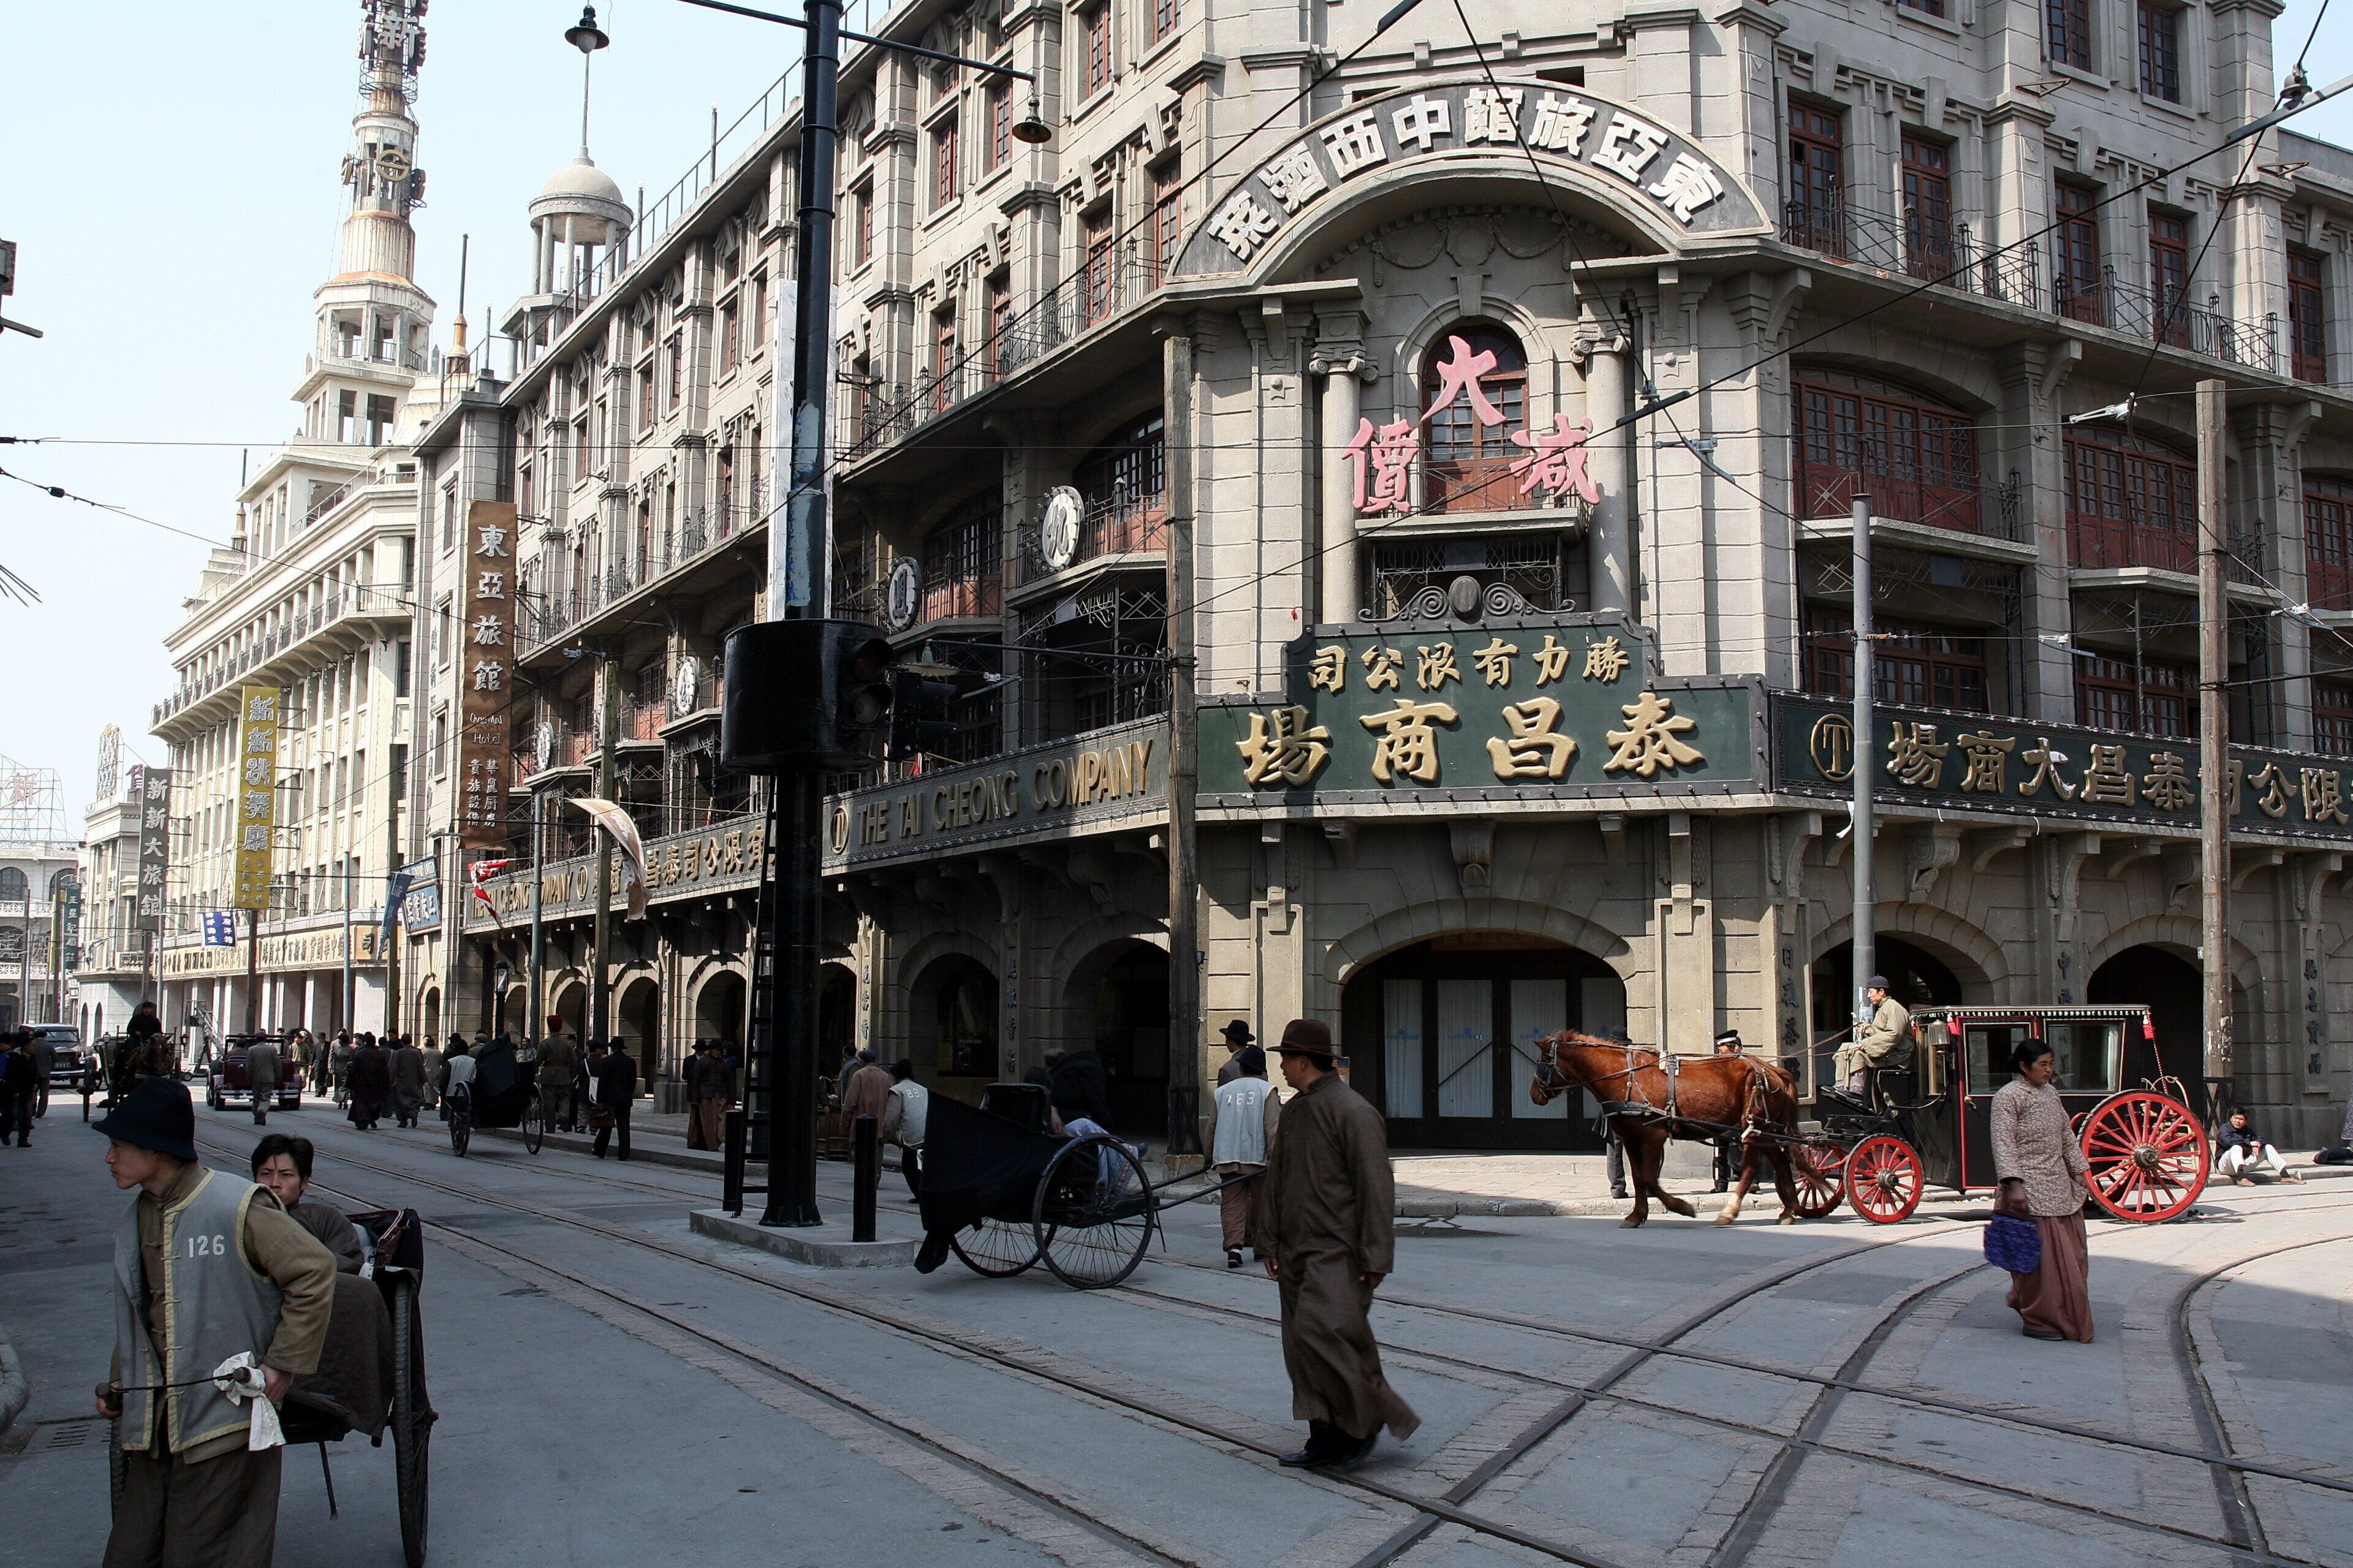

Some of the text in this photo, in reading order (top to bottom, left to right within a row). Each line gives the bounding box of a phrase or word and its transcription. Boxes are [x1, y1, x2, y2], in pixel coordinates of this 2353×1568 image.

[382, 9, 420, 58] 新
[858, 738, 1154, 846] THE TAI CHEONG COMPANY
[188, 1234, 225, 1258] 126
